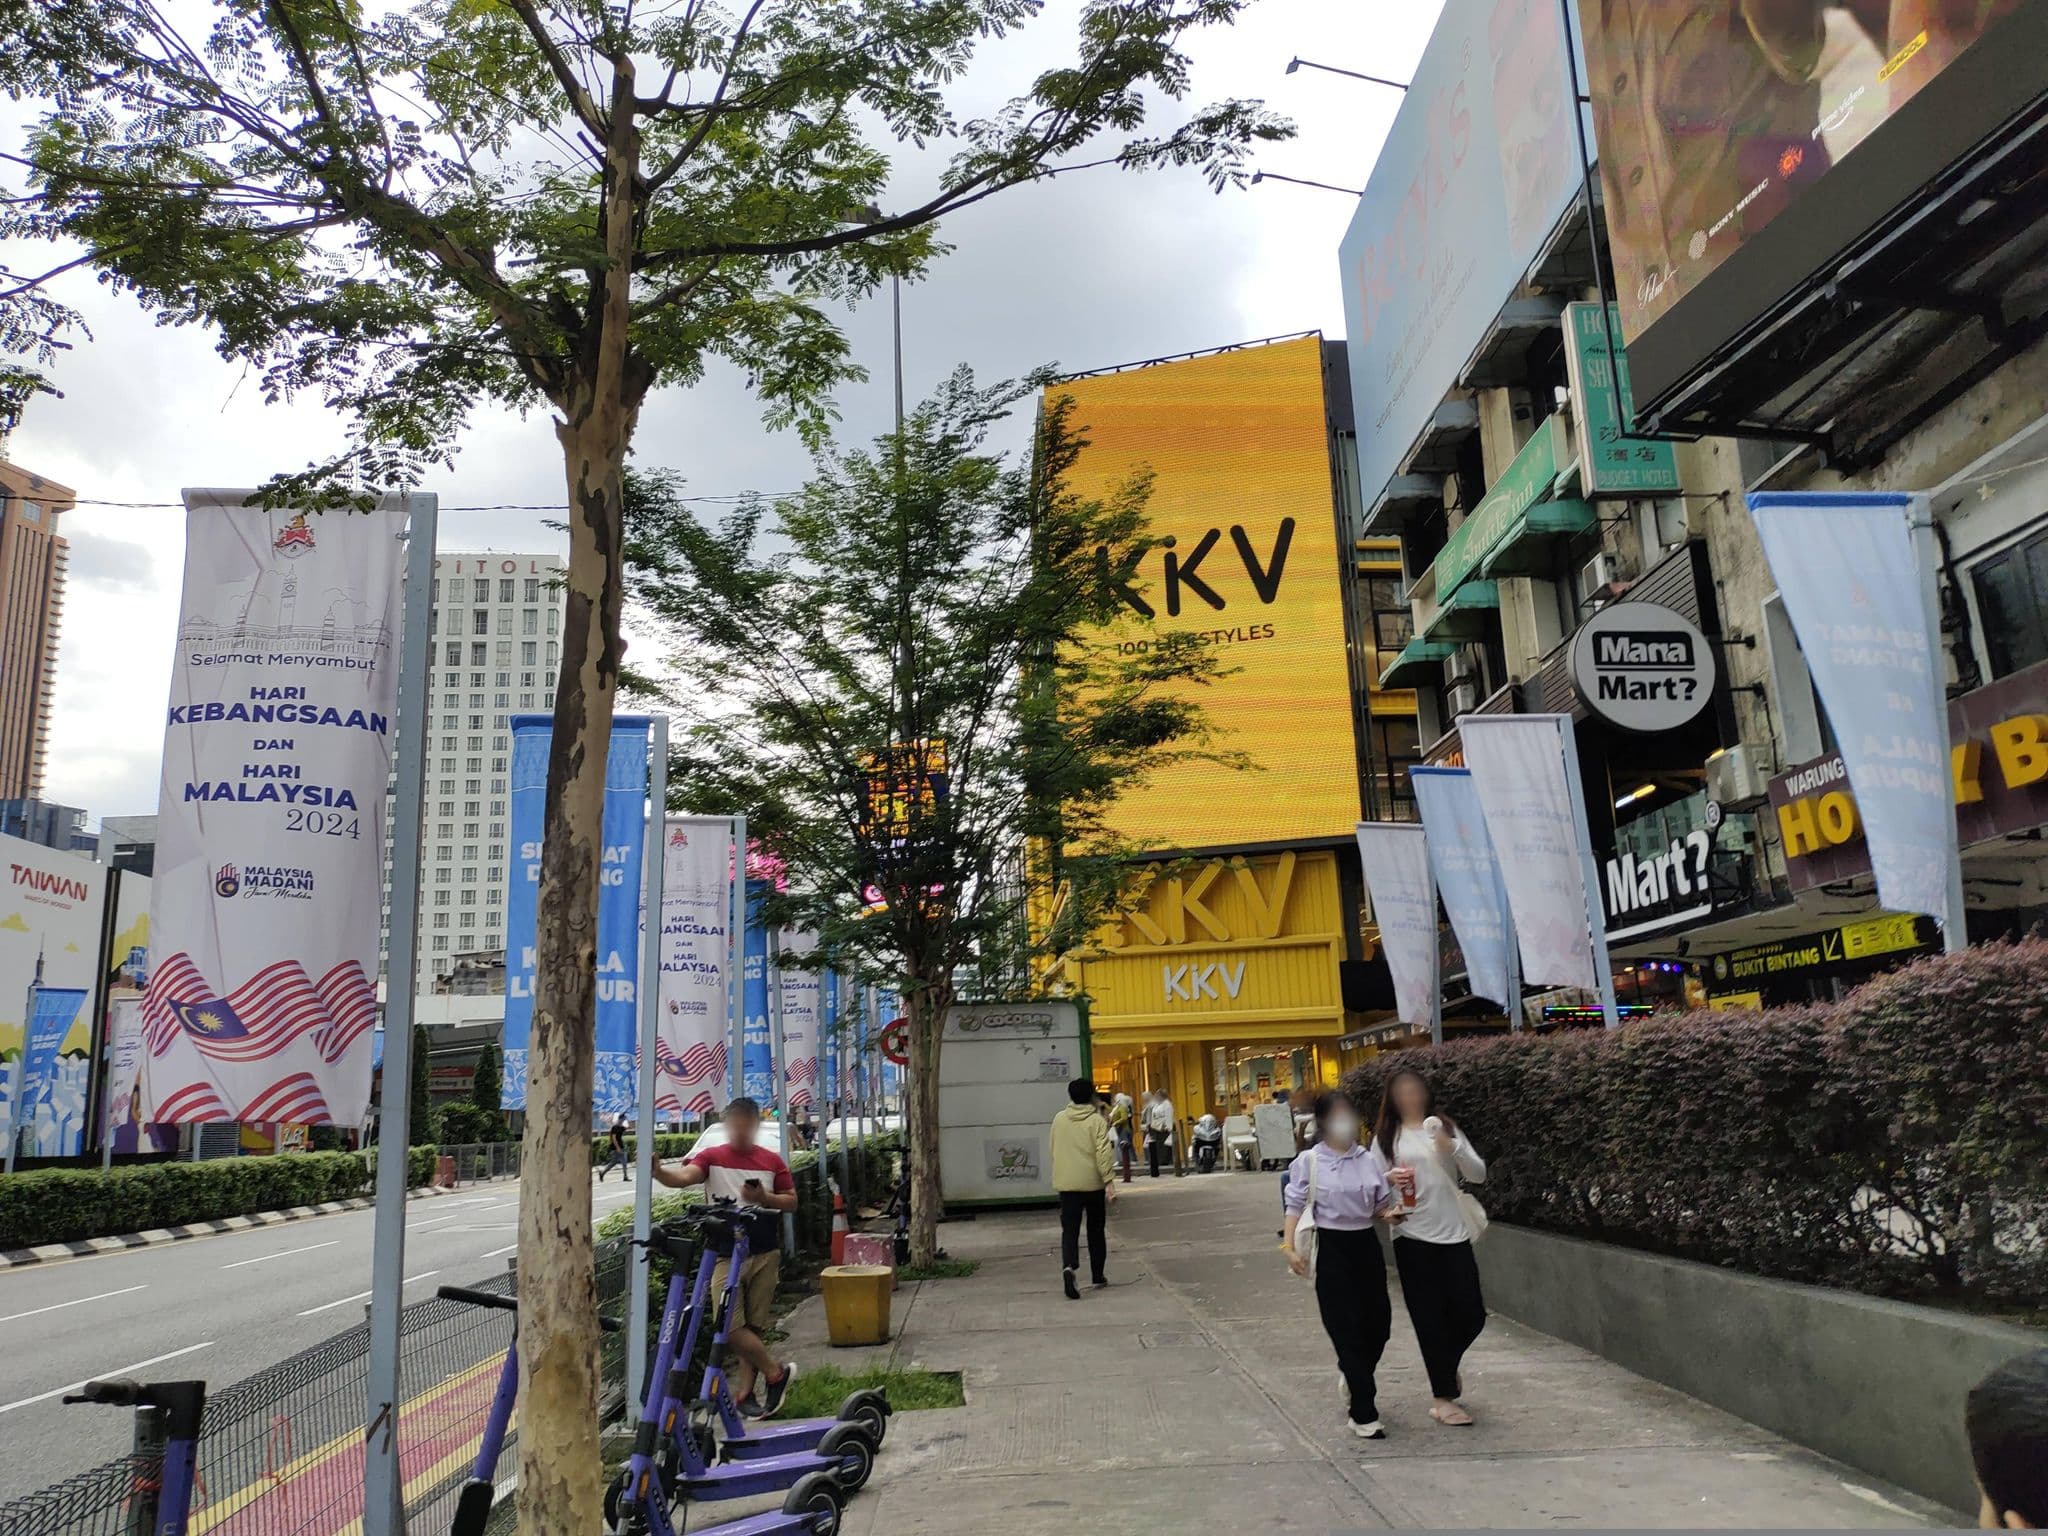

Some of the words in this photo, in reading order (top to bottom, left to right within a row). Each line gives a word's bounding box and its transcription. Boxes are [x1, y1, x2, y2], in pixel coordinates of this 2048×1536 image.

[1708, 209, 1735, 238] SONY
[1735, 178, 1769, 212] MUSIC
[1599, 470, 1640, 489] BUDGET
[1642, 470, 1675, 487] HOTEL
[1116, 640, 1148, 656] 100
[191, 653, 263, 667] Selamat
[268, 654, 376, 671] Menyambut
[250, 686, 306, 700] HARI
[1598, 675, 1698, 700] Mart?
[168, 702, 388, 735] KEBANGSAAN
[253, 739, 294, 750] DAN
[243, 764, 301, 778] HARI
[1784, 757, 1847, 797] WARUNG
[184, 782, 358, 811] MALAYSIA
[285, 808, 361, 840] 2024
[10, 864, 88, 902] TAIWAN
[244, 876, 314, 891] MADANI
[245, 867, 313, 879] MALAYSIA
[1606, 830, 1709, 916] Mart?
[671, 915, 695, 923] HARI
[1732, 960, 1765, 979] BUKIT
[1767, 947, 1820, 972] BINTANG
[692, 973, 721, 987] 2024
[661, 1310, 677, 1344] beam
